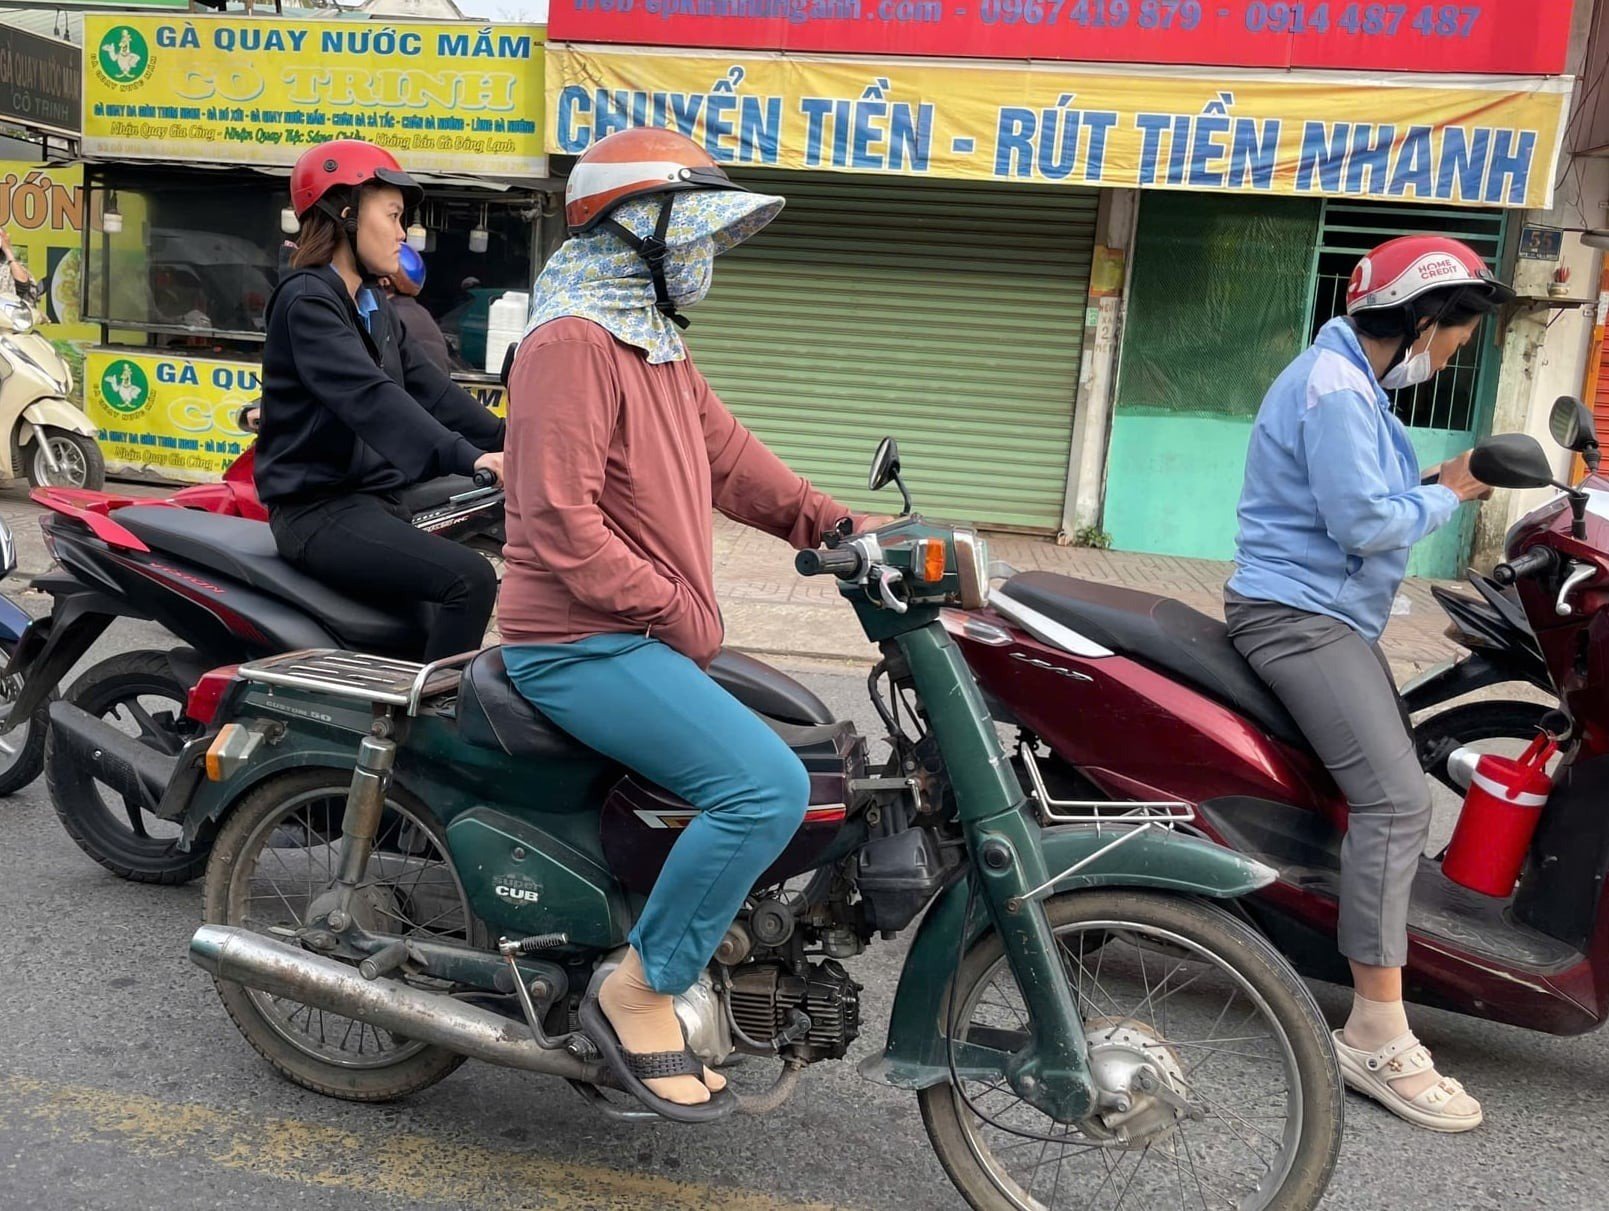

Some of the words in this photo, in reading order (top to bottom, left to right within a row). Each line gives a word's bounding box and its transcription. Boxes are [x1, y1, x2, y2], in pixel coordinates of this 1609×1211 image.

[980, 0, 1065, 25] 0967
[1069, 0, 1130, 28] 419
[1138, 0, 1203, 30] 879
[1245, 1, 1330, 34] 0914
[1337, 3, 1407, 36] 487
[1411, 5, 1482, 37] 487
[156, 21, 200, 48] GÀ
[214, 28, 308, 52] QUAY
[321, 27, 422, 56] NƯỚC
[437, 27, 531, 59] MẮM
[280, 65, 517, 111] TRINH
[12, 89, 31, 113] CÔ
[34, 97, 69, 121] TRINH
[255, 128, 283, 145] Quay
[557, 65, 784, 165] CHUYỂN
[799, 77, 935, 172] TIỀN
[993, 93, 1118, 184] RÚT
[1135, 91, 1283, 190] TIỀN
[1294, 120, 1538, 205] NHANH
[1418, 259, 1452, 273] HOME
[1421, 265, 1457, 280] CREDIT
[156, 360, 199, 386] GÀ
[310, 710, 332, 723] 50
[495, 885, 539, 902] CUB
